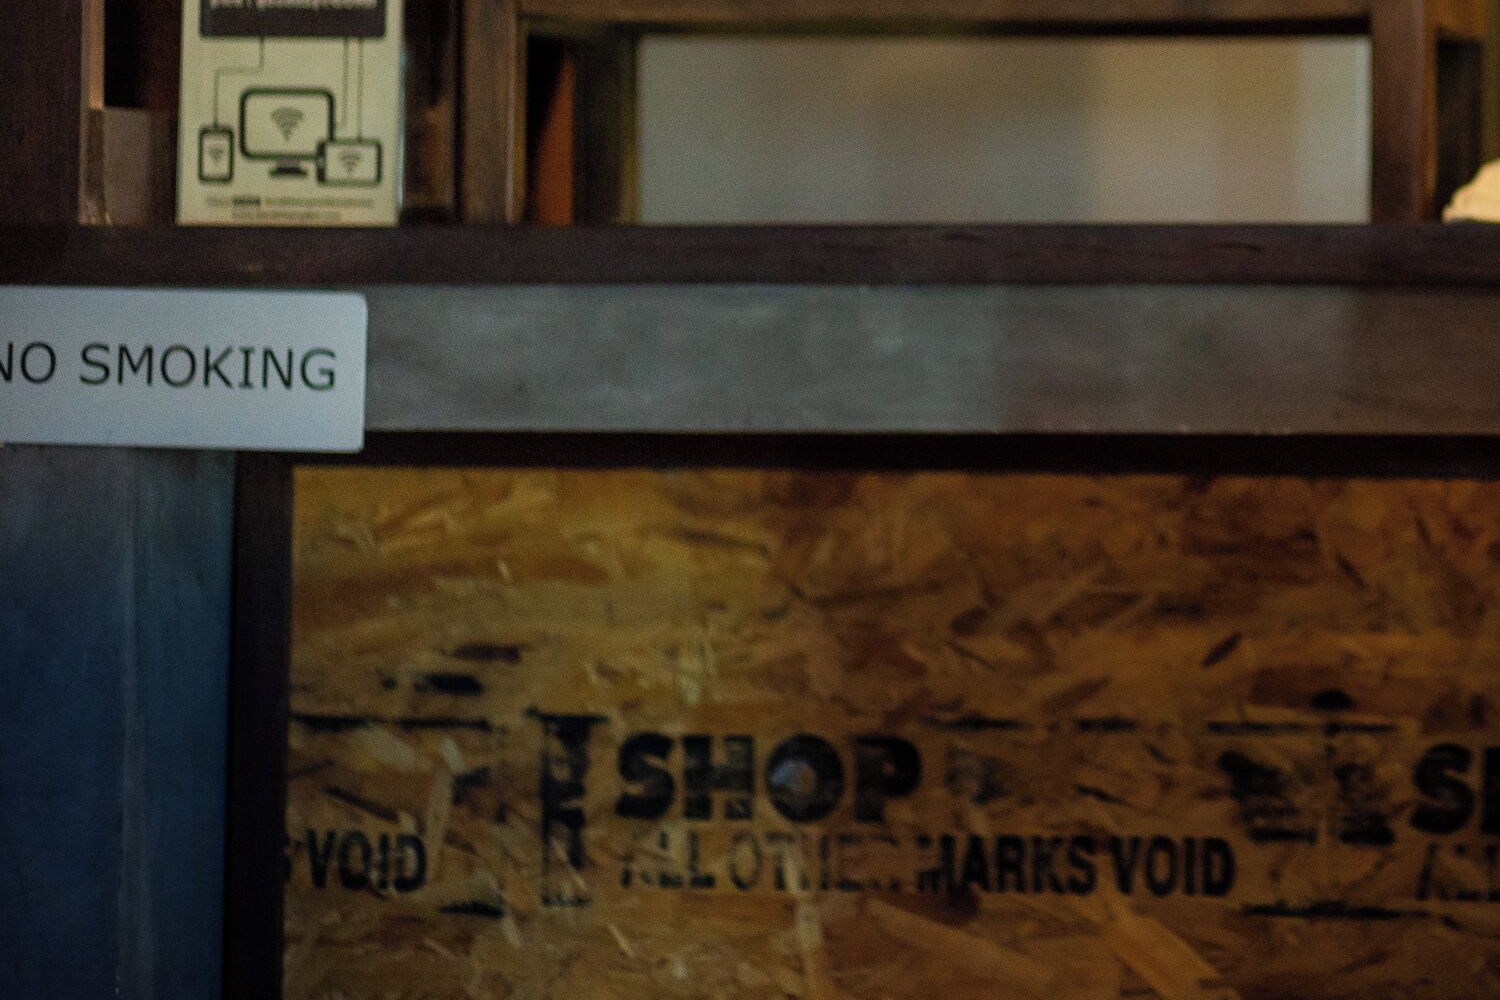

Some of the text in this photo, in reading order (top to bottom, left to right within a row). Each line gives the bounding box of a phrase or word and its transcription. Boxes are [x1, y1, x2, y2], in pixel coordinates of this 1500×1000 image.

[79, 343, 336, 391] SMOKING
[616, 733, 921, 822] SHOP
[305, 830, 426, 891] VOID
[1110, 835, 1236, 895] VOID
